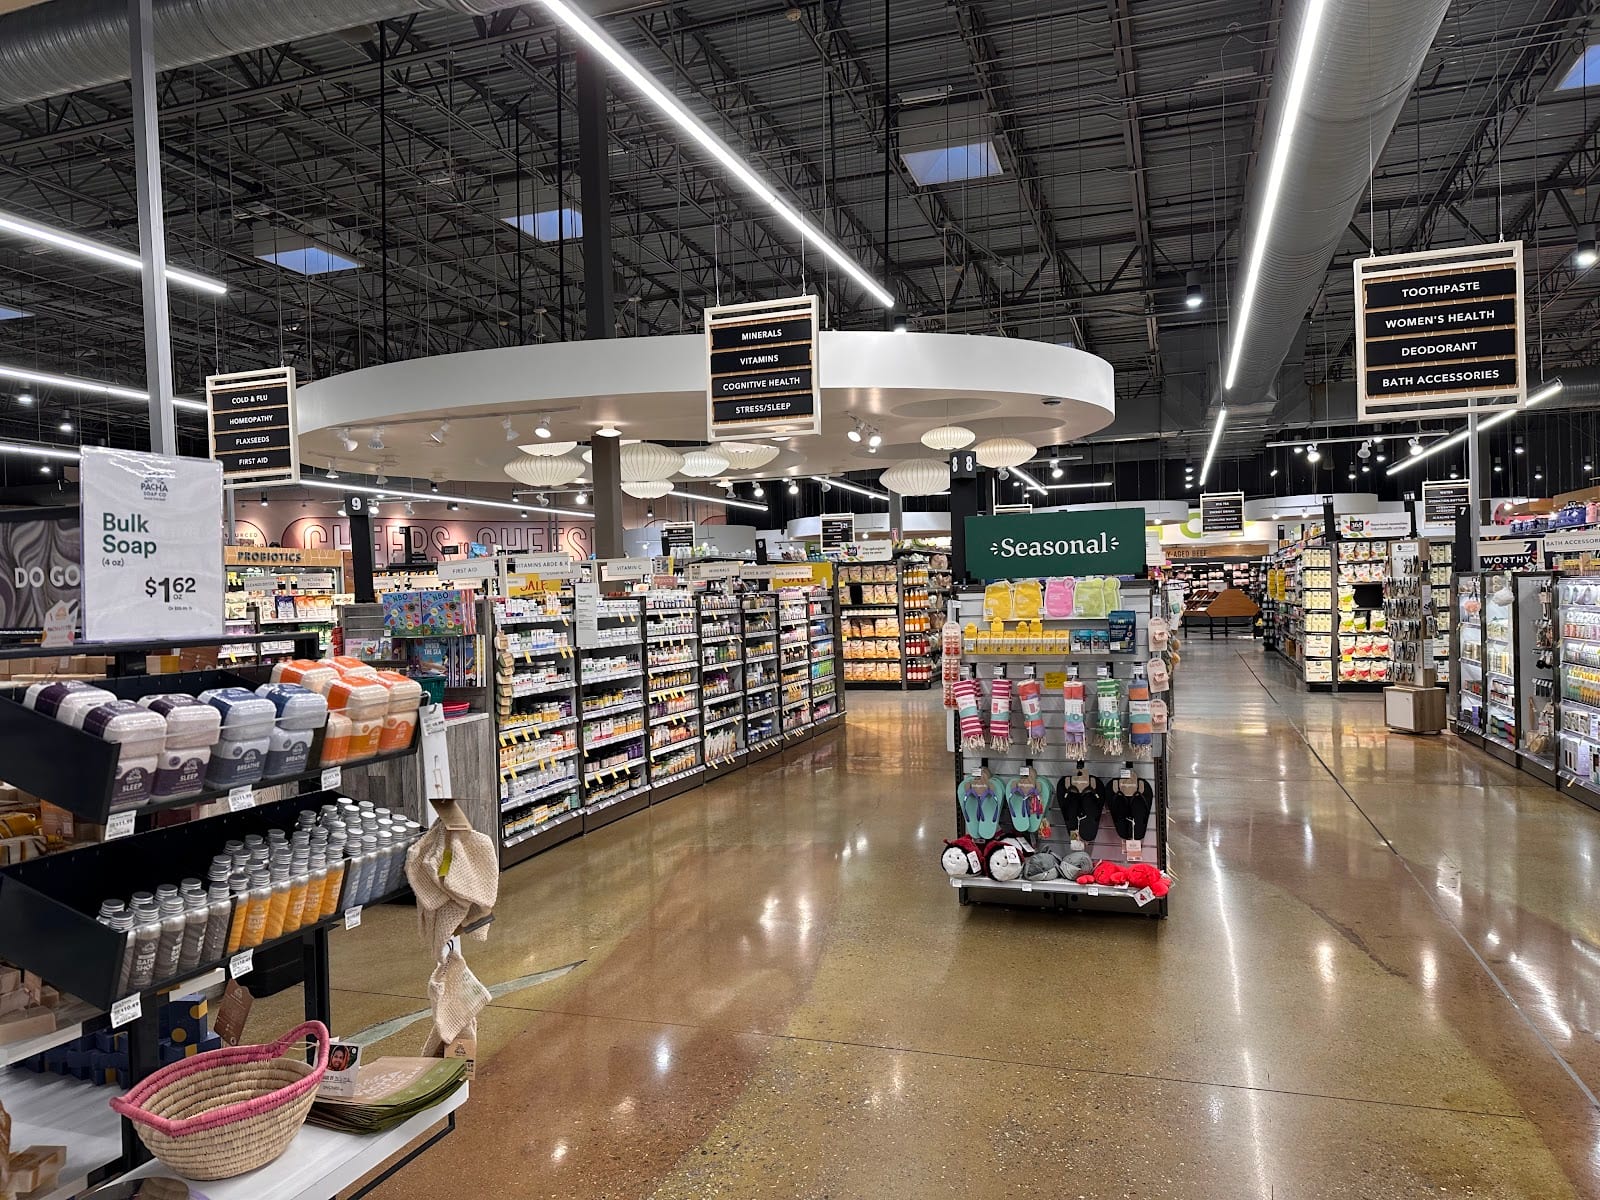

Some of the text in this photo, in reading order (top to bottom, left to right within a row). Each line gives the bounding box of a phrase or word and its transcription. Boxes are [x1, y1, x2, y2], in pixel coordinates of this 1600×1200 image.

[1401, 282, 1480, 297] TOOTHPASTE
[1385, 310, 1495, 329] WOMEN'S HEALTH
[741, 329, 782, 340] MINERALS
[1401, 341, 1477, 356] DEODORANT
[740, 355, 779, 365] VITAMINS
[1382, 369, 1500, 387] BATH ACCESSORIES
[722, 377, 800, 391] COGNITIVE HEALTH
[231, 396, 249, 404] COLD
[735, 402, 791, 414] STRESS/SLEEP
[229, 415, 273, 425] HOMEOPATHY
[235, 436, 270, 445] FLAXSEEDS
[952, 455, 973, 473] 8 8
[140, 482, 168, 493] PACHA
[351, 497, 361, 510] 9
[1460, 507, 1467, 515] 7
[102, 512, 149, 533] Bulk
[102, 534, 157, 558] Soap
[1001, 532, 1108, 558] Seasonal
[238, 551, 302, 562] PROBIOTICS
[1483, 555, 1531, 565] WORTHY
[102, 558, 125, 567] (4 oz)
[14, 566, 45, 588] DO
[236, 761, 260, 771] BREATHE
[180, 772, 199, 782] SLEEP
[122, 782, 143, 792] SLEEP
[137, 958, 155, 966] BATH
